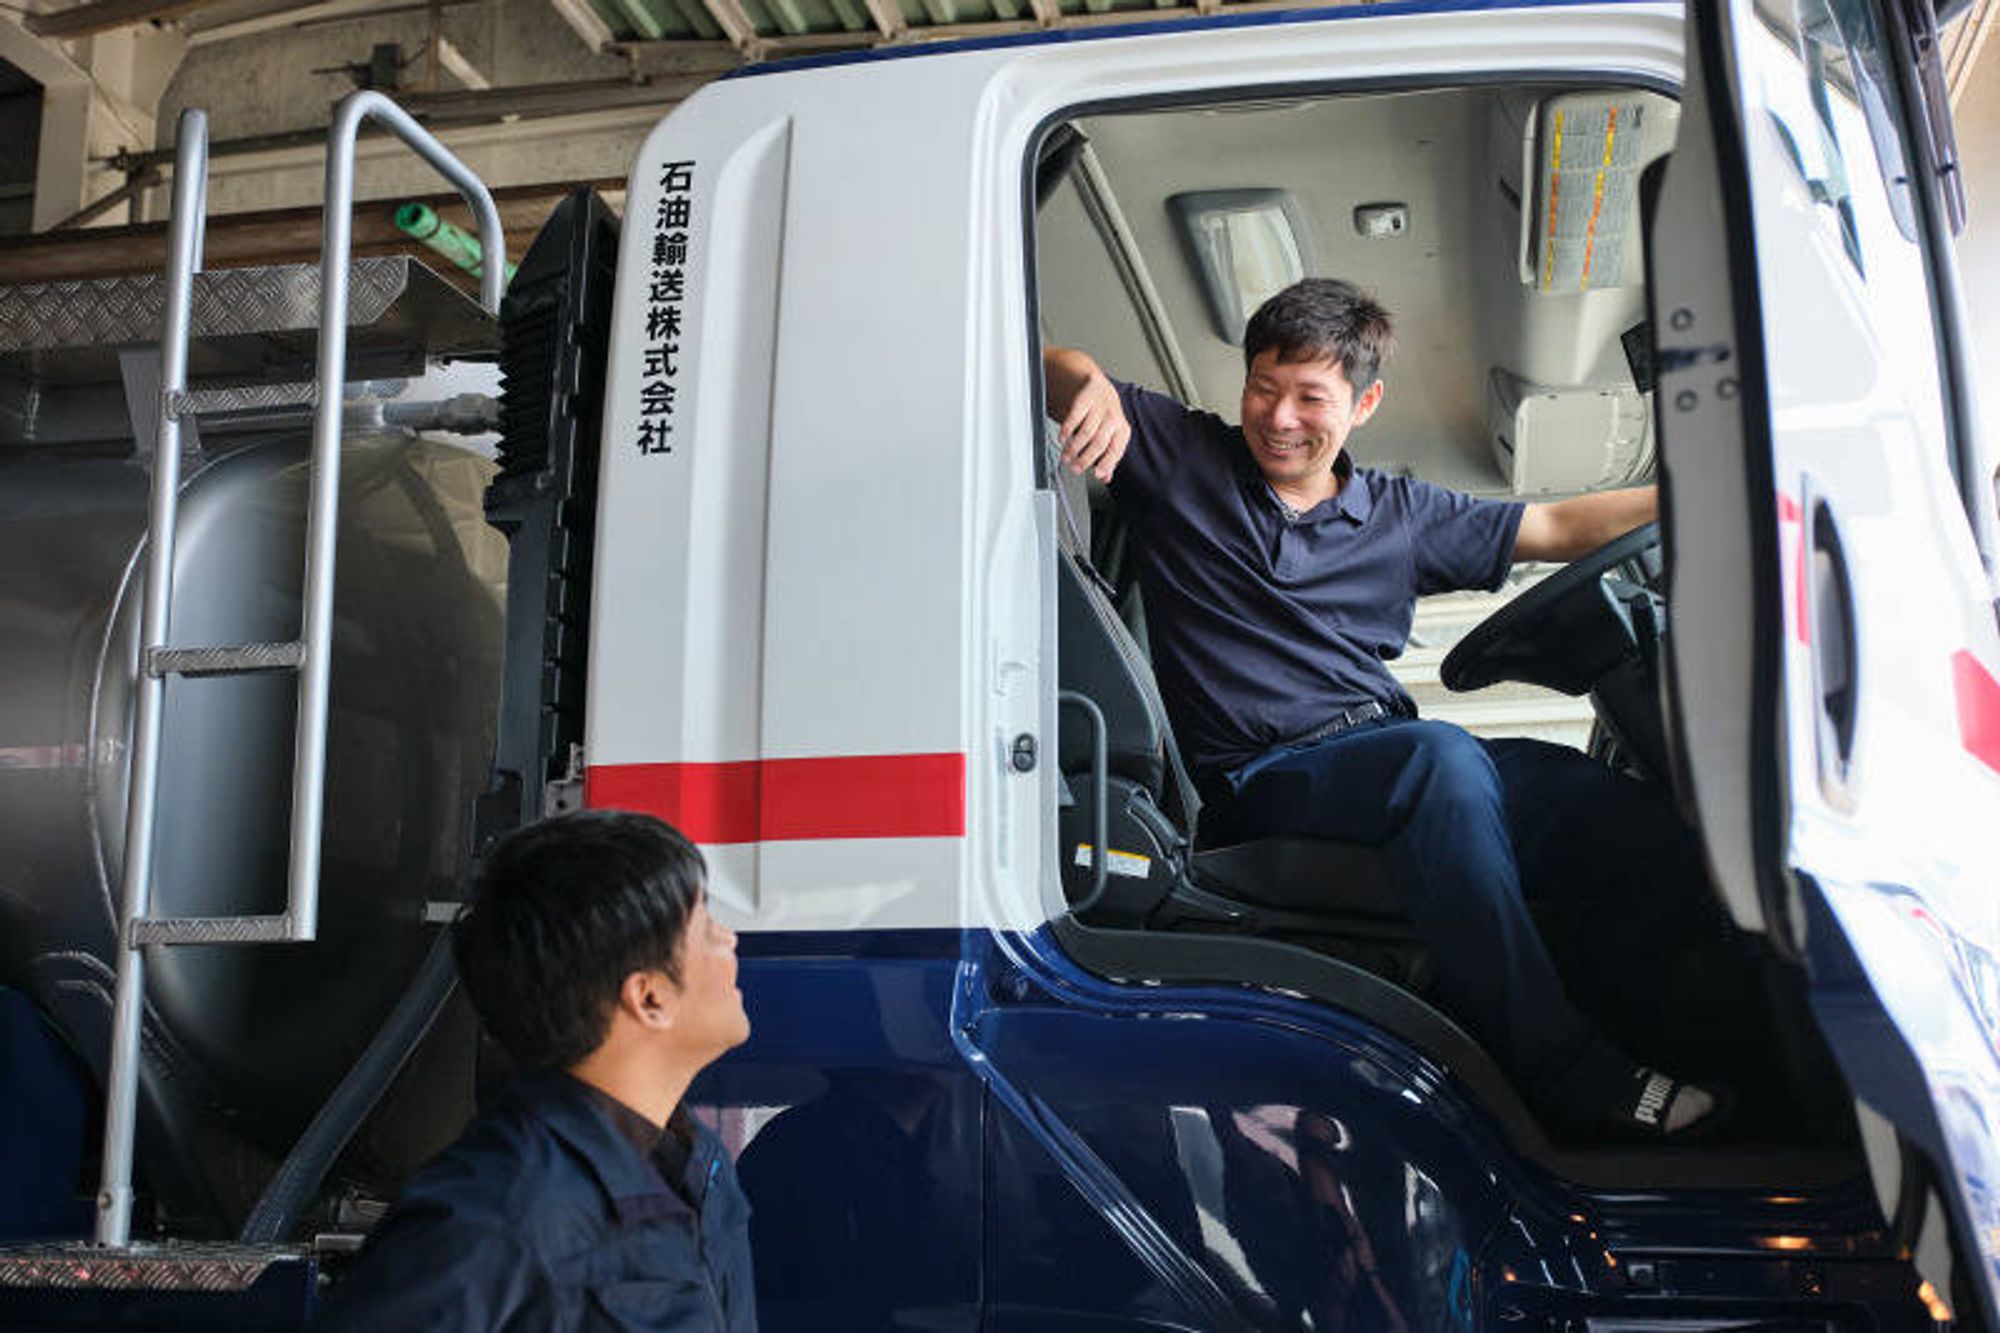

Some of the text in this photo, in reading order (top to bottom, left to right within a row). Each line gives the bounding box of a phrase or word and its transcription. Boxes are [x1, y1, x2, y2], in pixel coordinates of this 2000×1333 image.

[636, 160, 697, 456] 石油輸送株式会社
